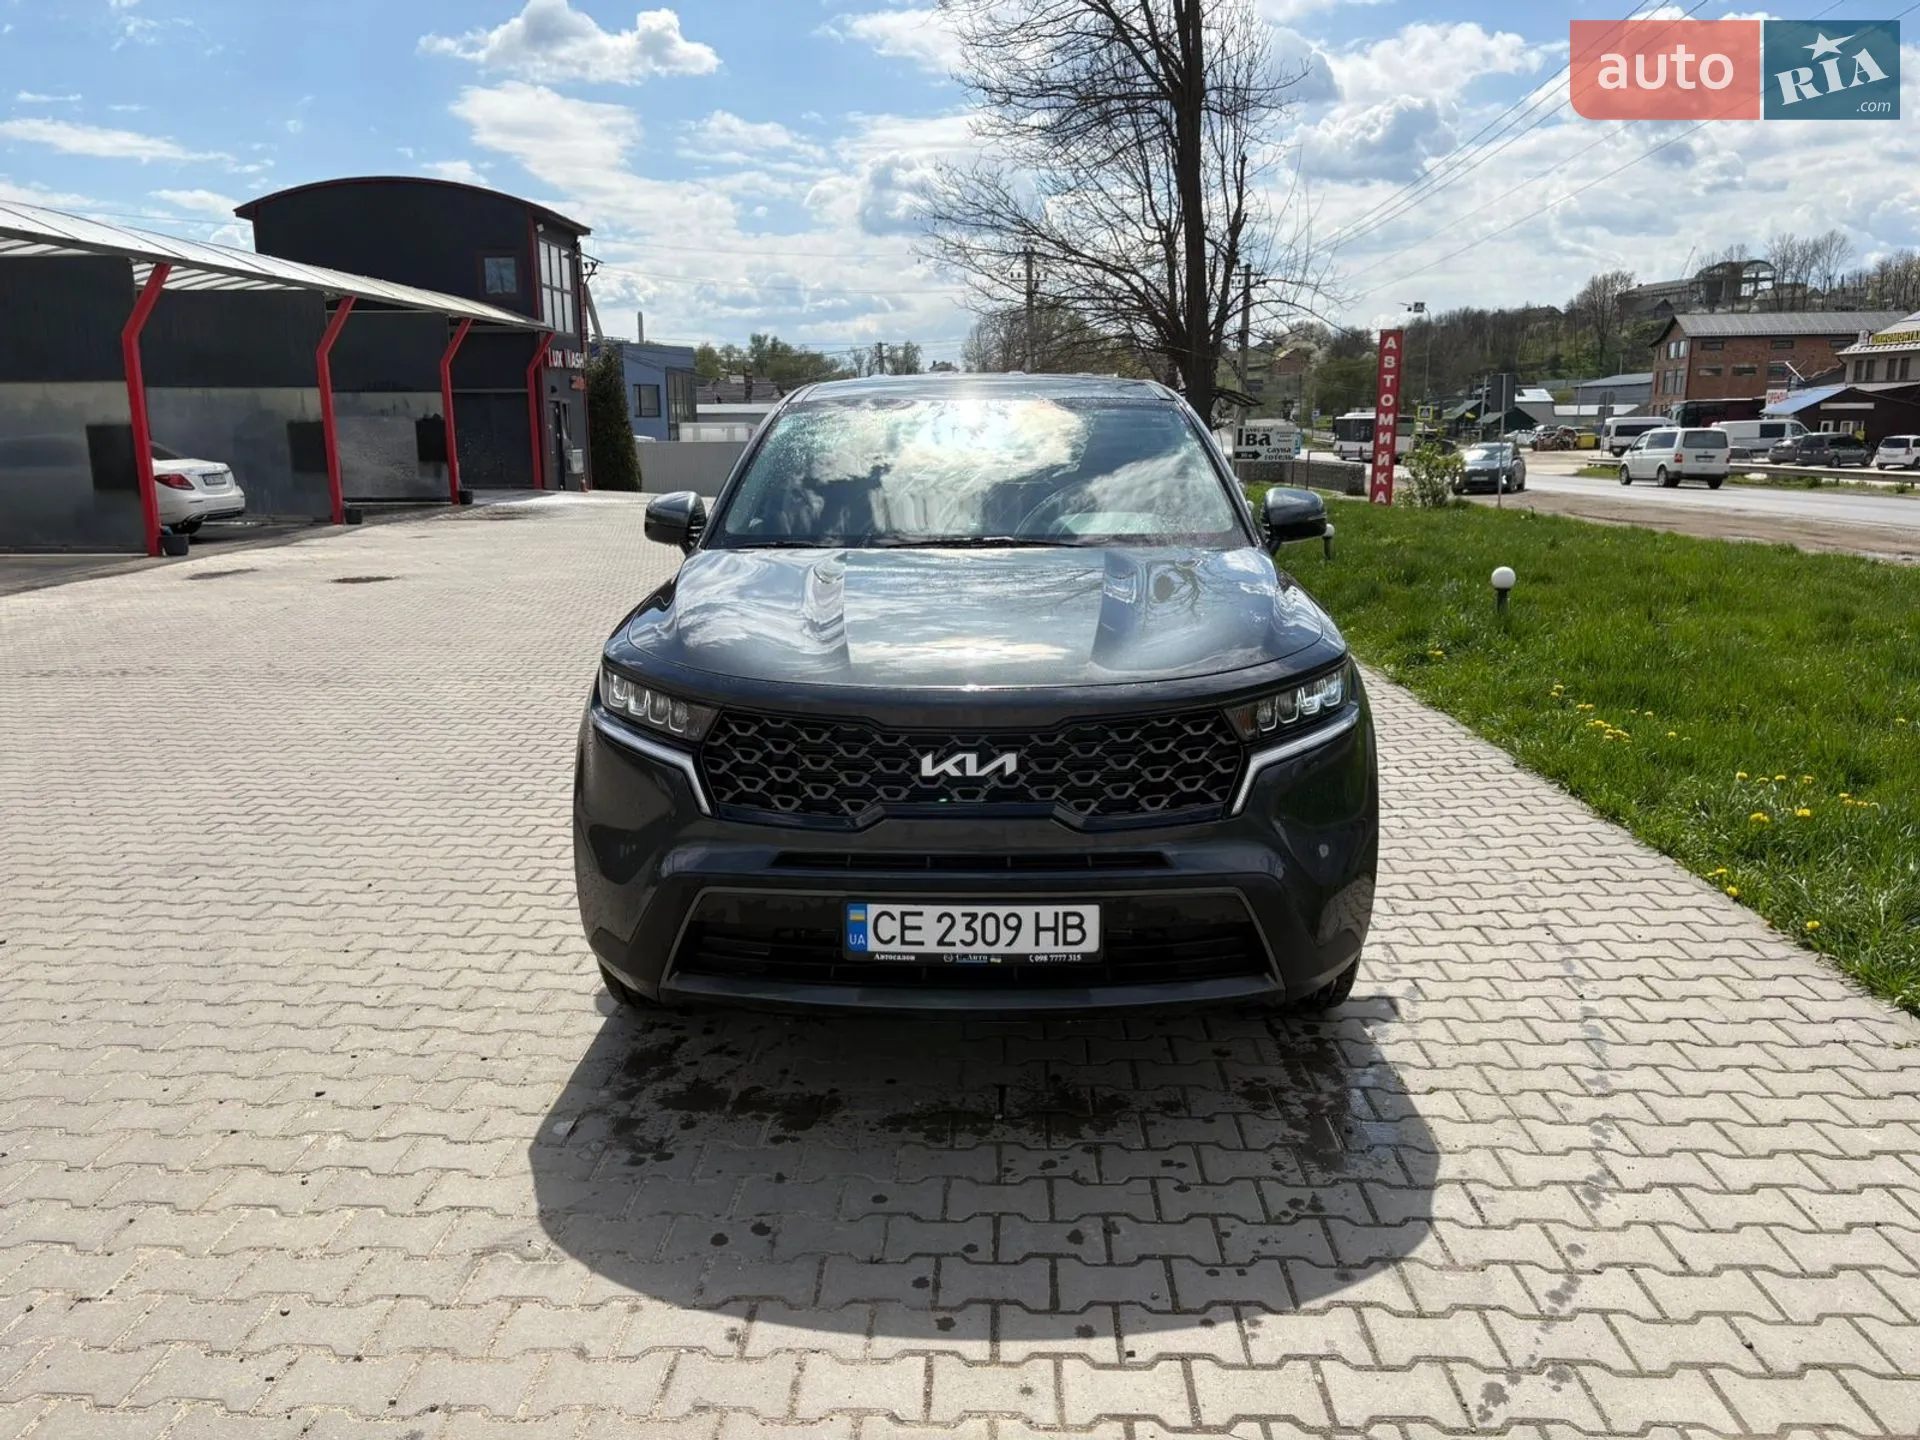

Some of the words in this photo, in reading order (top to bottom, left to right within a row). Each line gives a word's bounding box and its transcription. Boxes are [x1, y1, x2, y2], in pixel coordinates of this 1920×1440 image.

[1871, 331, 1920, 345] ШИНОМОНТА
[1375, 336, 1397, 503] АВТОМИЙКА
[921, 753, 1017, 777] KIA
[849, 933, 866, 946] UA
[872, 911, 925, 946] CE
[936, 911, 1023, 947] 2309
[1034, 911, 1087, 946] HB
